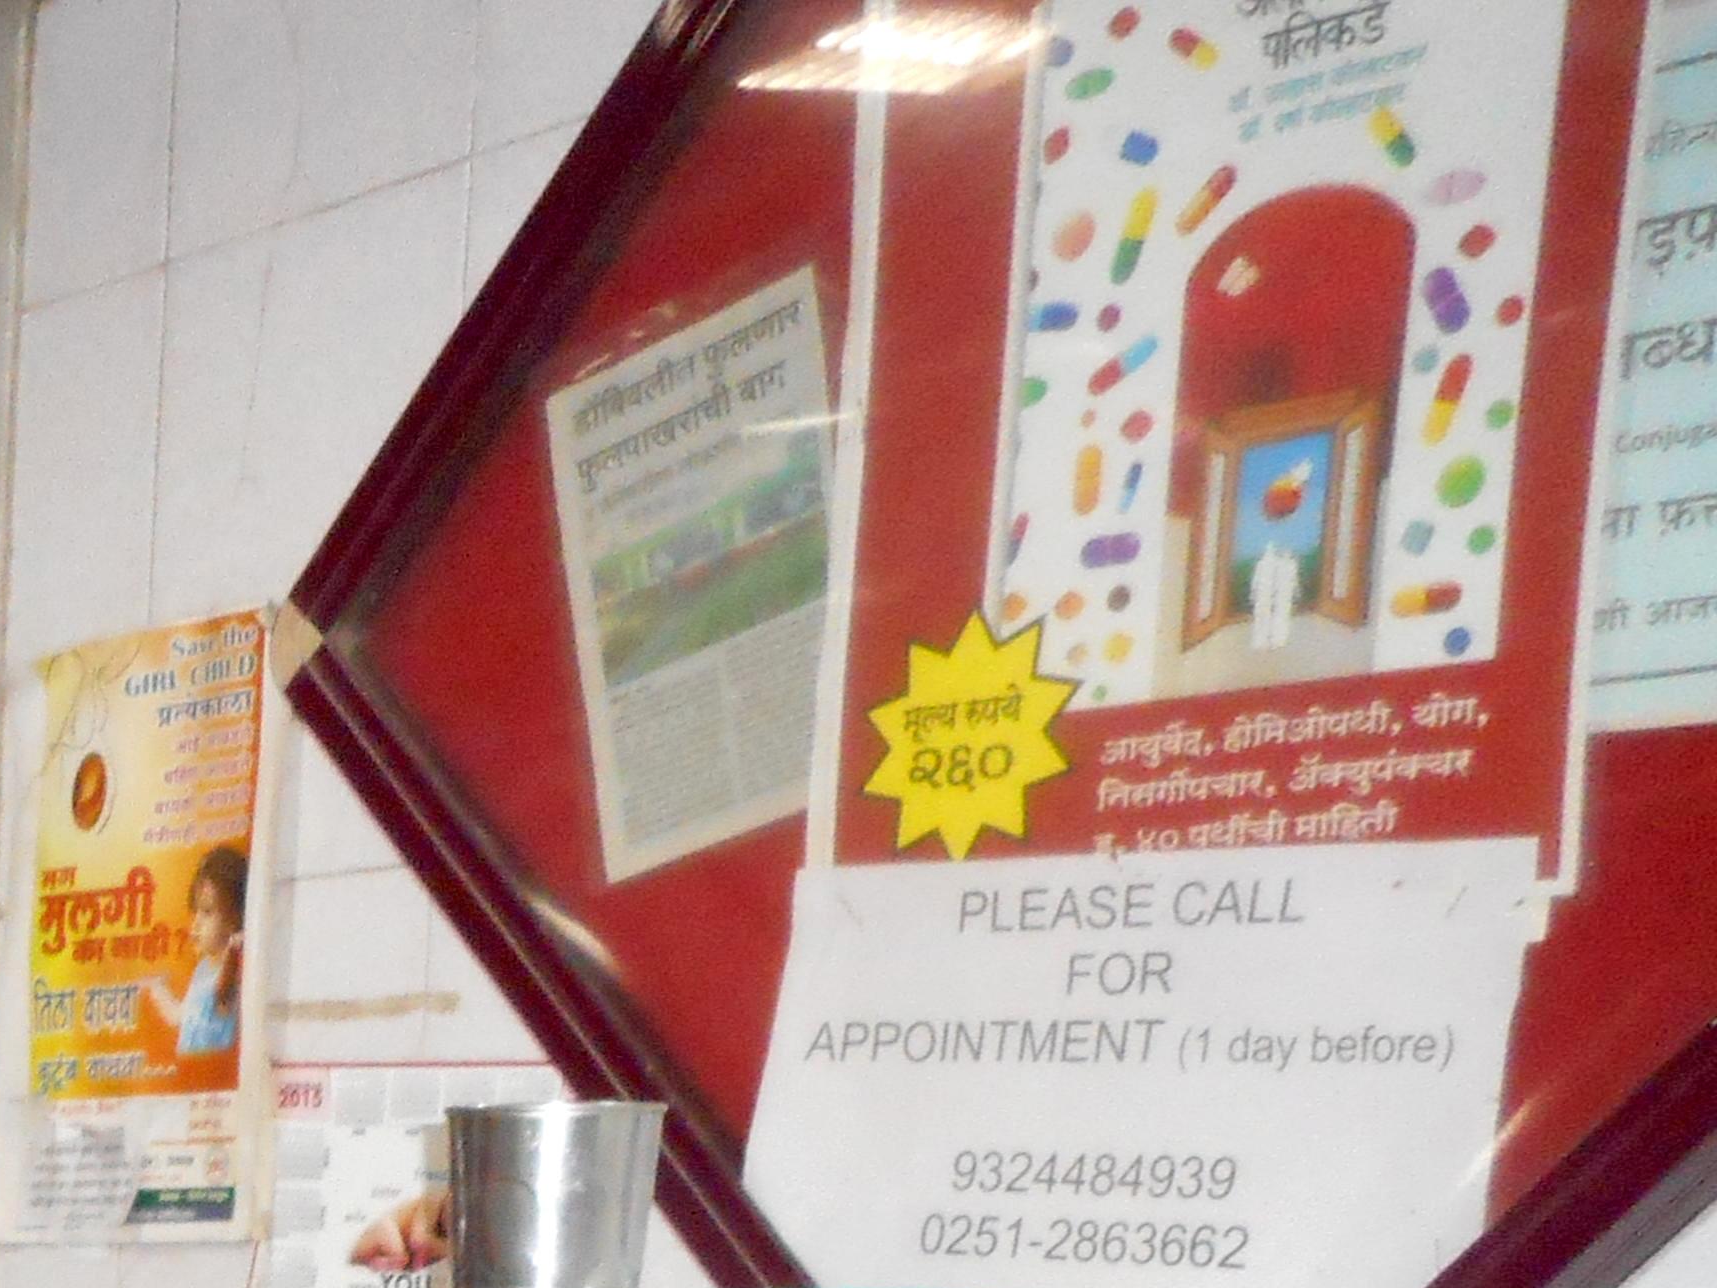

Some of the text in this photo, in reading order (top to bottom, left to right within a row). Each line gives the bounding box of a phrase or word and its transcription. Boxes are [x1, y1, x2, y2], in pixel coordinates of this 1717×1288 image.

[1615, 422, 1717, 453] Conjuga
[222, 623, 256, 647] the
[126, 654, 255, 696] GIRL CHILD
[902, 705, 957, 745] मूल्य
[908, 744, 1015, 792] २६०
[40, 866, 158, 956] मुलगी
[957, 878, 1307, 934] PLEASE CALL
[1064, 951, 1173, 997] FOR
[34, 977, 76, 1033] तिला
[803, 1018, 1457, 1072] APPOINTMENT (1 day before)
[950, 1150, 1239, 1202] 9324484939
[919, 1213, 1251, 1272] 0251-2863662
